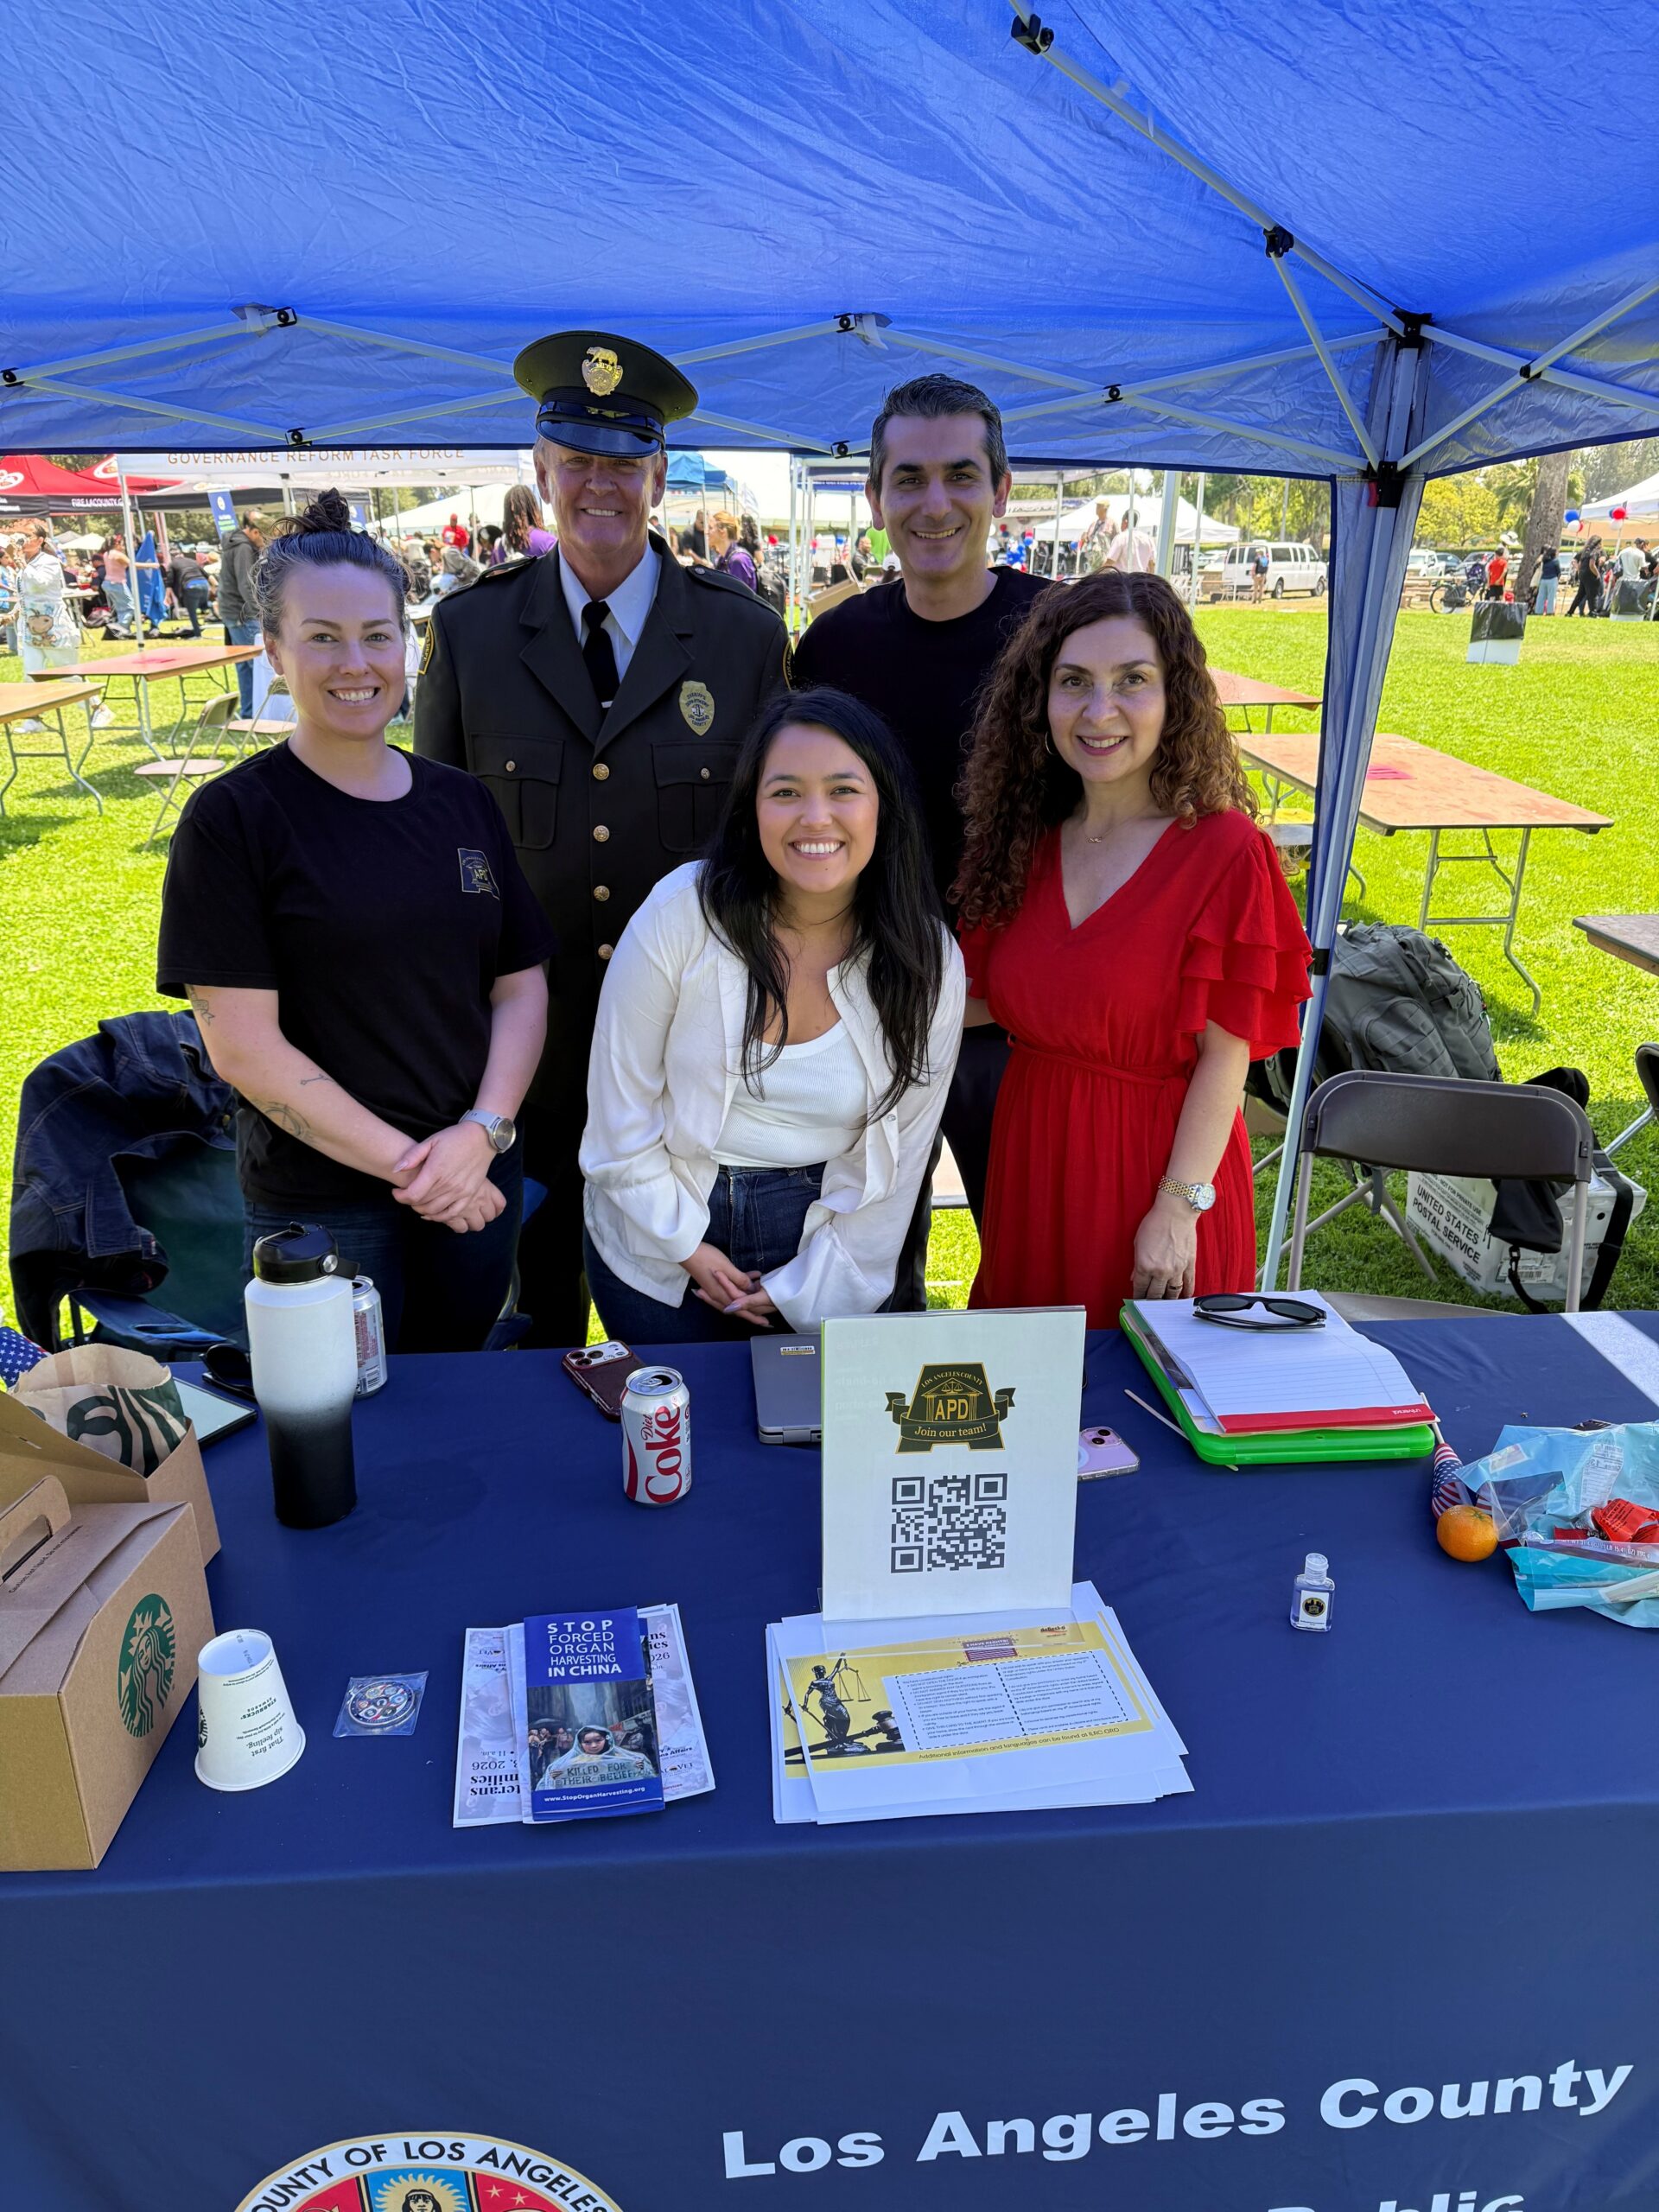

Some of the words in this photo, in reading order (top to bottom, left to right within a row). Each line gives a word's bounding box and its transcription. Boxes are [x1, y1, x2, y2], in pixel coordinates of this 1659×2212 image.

[168, 452, 279, 464] GOVERNANCE
[287, 451, 353, 462] REFORM
[362, 450, 402, 461] TASK
[410, 449, 465, 460] FORCE
[1417, 1185, 1444, 1216] UNITED
[1445, 1211, 1479, 1244] STATES
[1413, 1197, 1440, 1231] POSTAL
[1442, 1225, 1481, 1264] SERVICE
[921, 1378, 933, 1388] LOS
[933, 1371, 960, 1380] ANGELES
[961, 1371, 982, 1385] COUNTY
[934, 1398, 969, 1421] APD
[640, 1414, 653, 1441] Diet
[914, 1426, 937, 1437] Join
[958, 1422, 987, 1436] team!
[645, 1406, 683, 1503] Coke
[547, 1619, 613, 1634] STOP
[550, 1631, 614, 1644] FORCED
[550, 1642, 614, 1655] ORGAN
[550, 1653, 616, 1666] HARVESTING
[548, 1667, 565, 1677] IN
[569, 1663, 622, 1676] CHINA
[274, 1726, 283, 1736] sip
[246, 1734, 273, 1749] feeling.
[268, 1736, 283, 1750] That
[251, 1745, 267, 1757] first
[952, 1747, 988, 1756] information
[472, 1760, 505, 1770] 2026
[567, 1765, 599, 1777] KILLED
[607, 1763, 627, 1772] FOR
[470, 1773, 518, 1786] milies
[470, 1784, 520, 1796] terans
[543, 1786, 645, 1802] www.StopOrganHarvesting.org
[723, 2131, 886, 2179] Los
[916, 2093, 1286, 2162] Angeles
[1319, 2059, 1634, 2129] County
[251, 2158, 334, 2212] UNTY
[344, 2144, 389, 2167] OF
[403, 2141, 466, 2160] LOS
